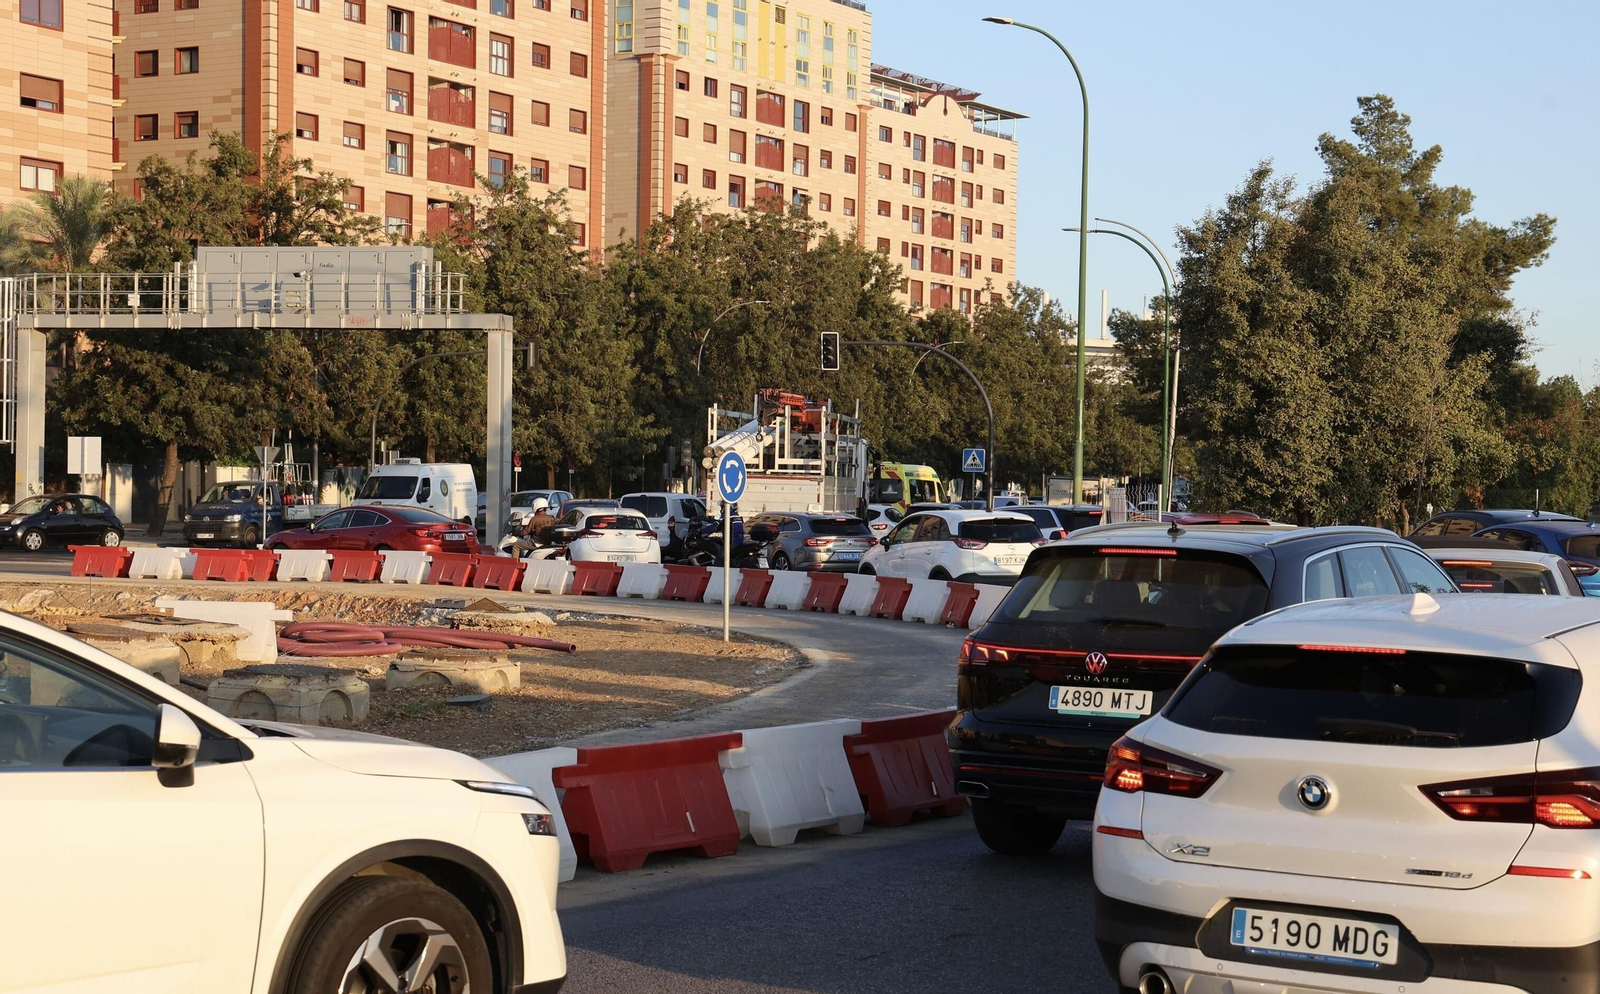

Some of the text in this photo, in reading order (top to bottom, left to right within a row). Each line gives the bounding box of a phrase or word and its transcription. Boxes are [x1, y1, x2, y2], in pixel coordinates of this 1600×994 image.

[1060, 689, 1147, 711] 4890 MTJ
[1169, 842, 1211, 857] X2
[1235, 929, 1242, 938] E
[1249, 915, 1389, 958] 5190 MDG
